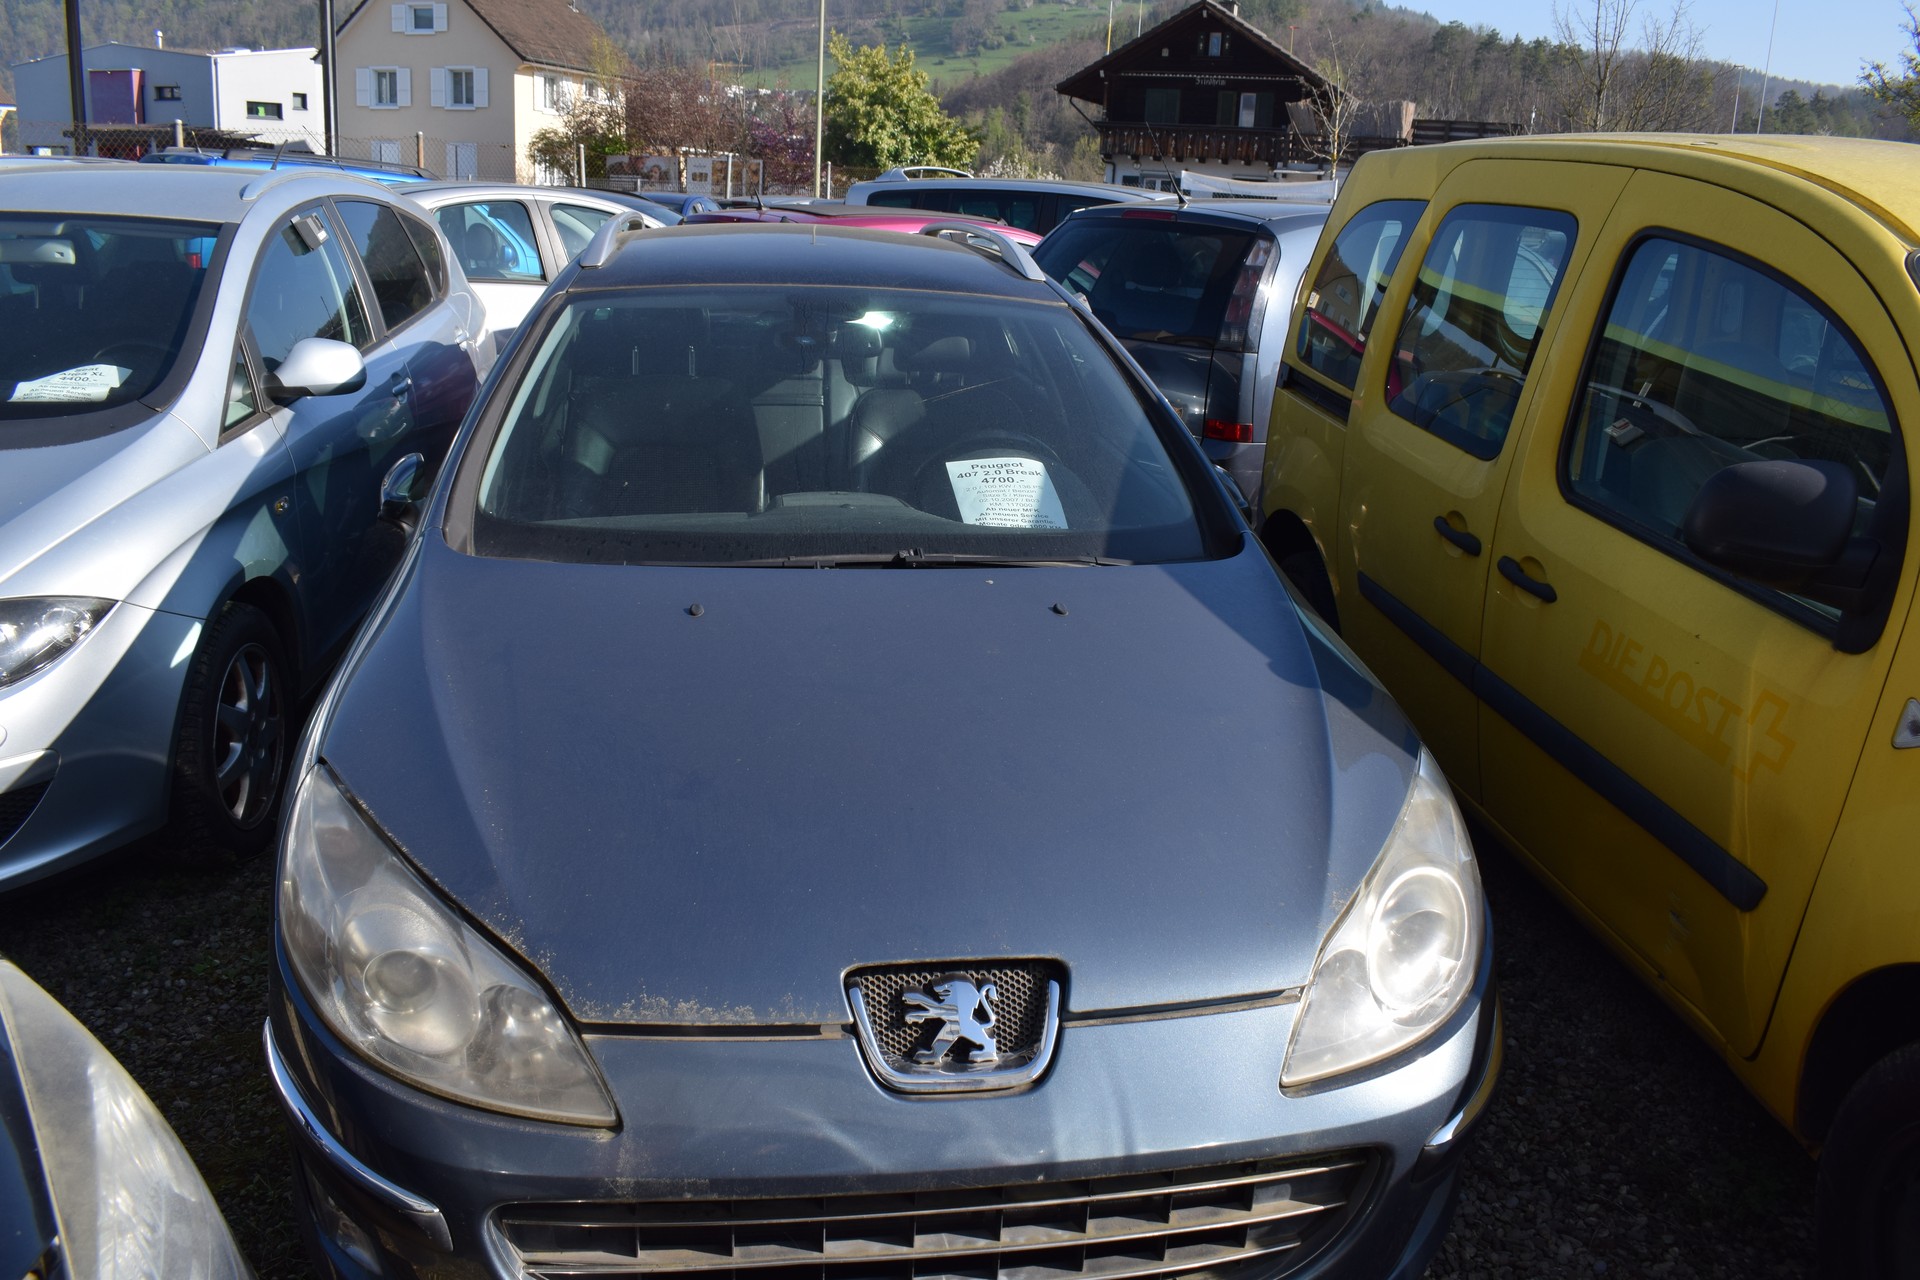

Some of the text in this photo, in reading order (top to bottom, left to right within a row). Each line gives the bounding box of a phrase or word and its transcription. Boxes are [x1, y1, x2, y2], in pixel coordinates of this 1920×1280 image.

[971, 462, 1025, 470] Peugeot
[957, 471, 979, 479] 407
[1005, 468, 1043, 477] Break
[981, 476, 1025, 484] 4700.-
[1586, 619, 1744, 741] DIE POST
